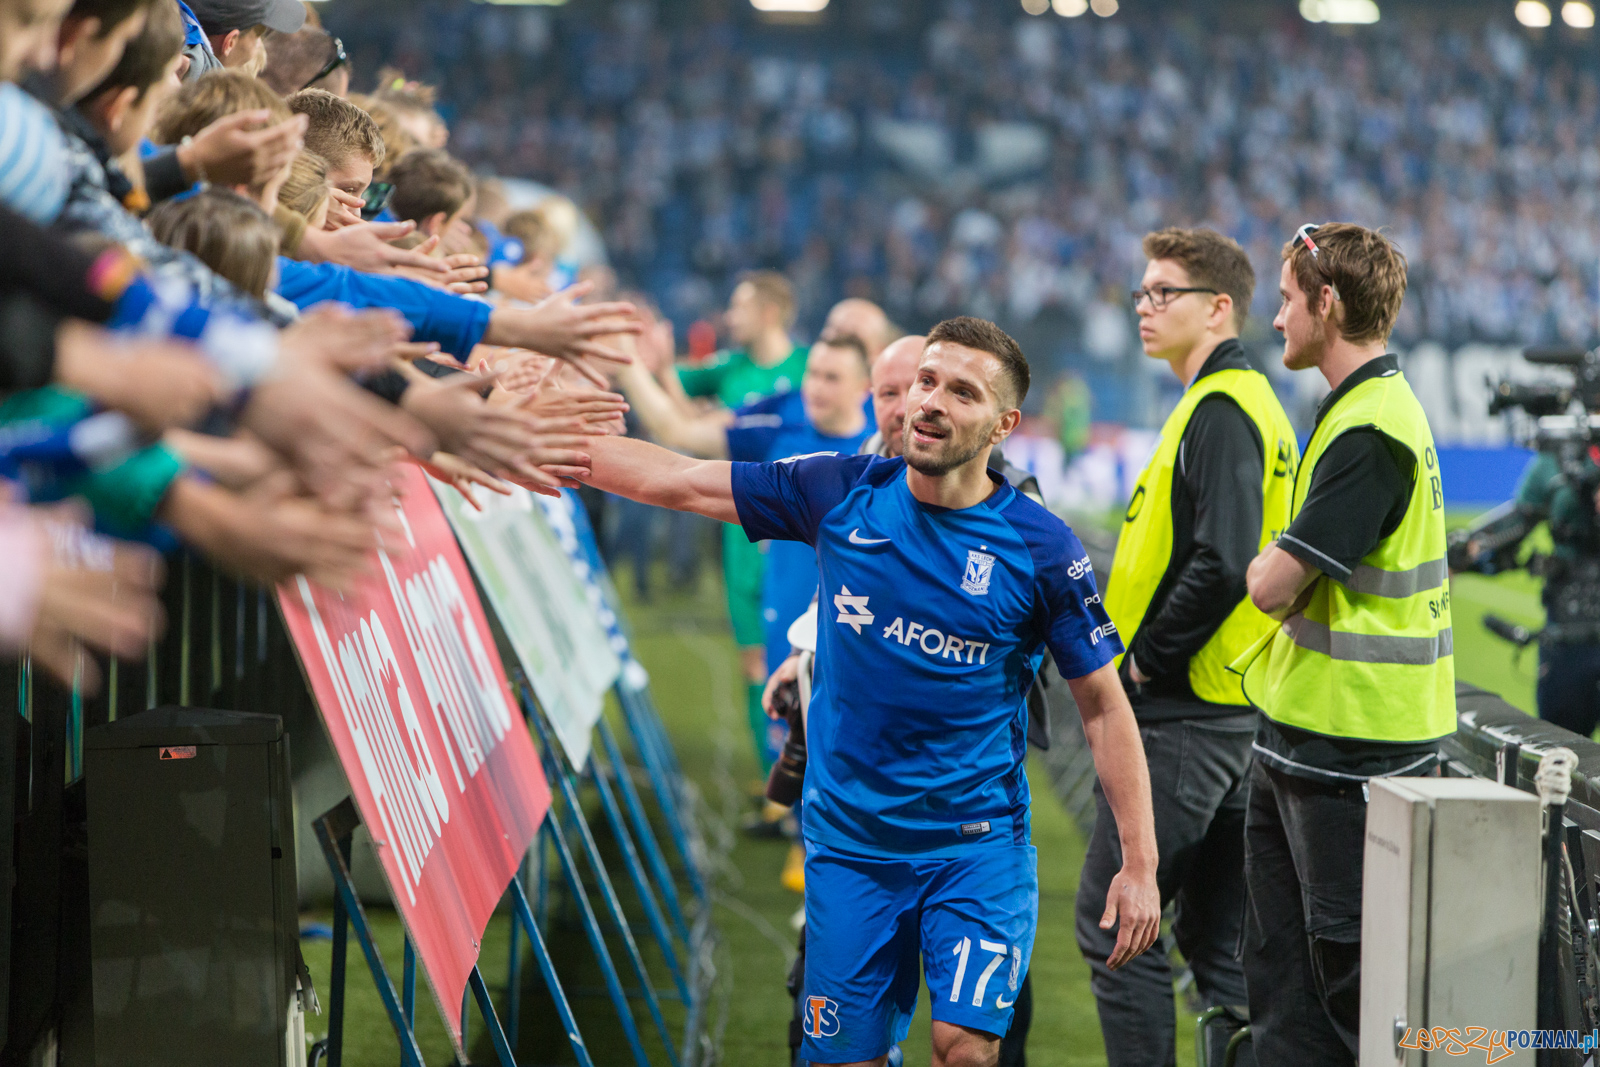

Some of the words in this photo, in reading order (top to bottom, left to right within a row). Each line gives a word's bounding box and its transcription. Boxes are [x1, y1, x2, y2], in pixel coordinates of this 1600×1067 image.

[883, 617, 990, 665] AFORTI
[296, 572, 449, 907] Amica
[375, 482, 512, 794] Amica
[950, 936, 1007, 1007] 17
[803, 995, 841, 1038] STS
